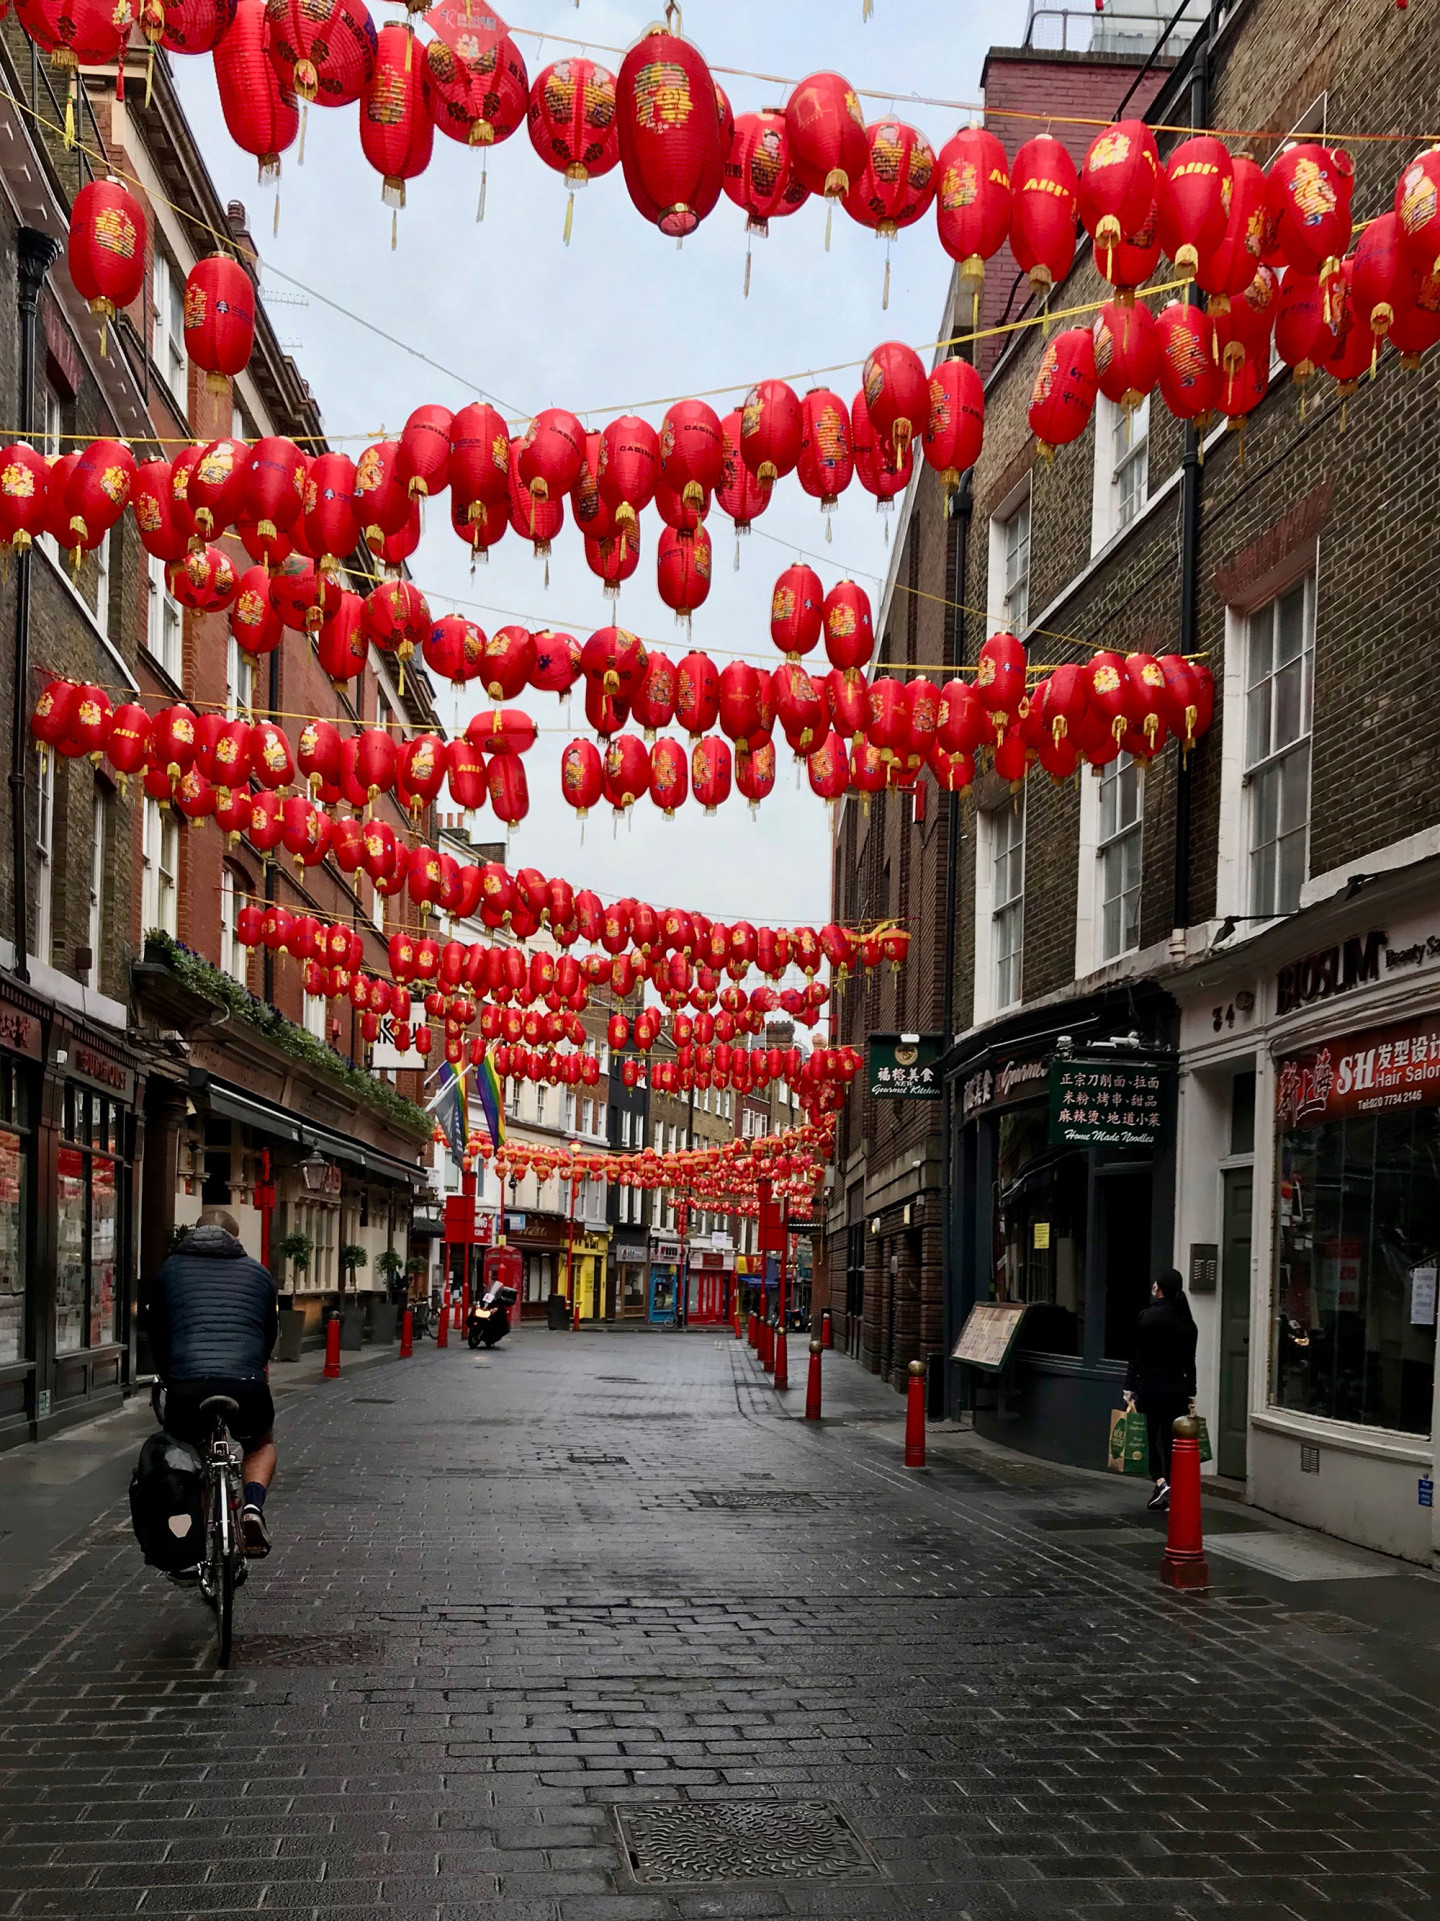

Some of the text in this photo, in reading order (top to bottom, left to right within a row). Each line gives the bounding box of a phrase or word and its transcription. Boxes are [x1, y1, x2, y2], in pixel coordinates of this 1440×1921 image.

[1386, 944, 1426, 968] Beauty
[1336, 1048, 1376, 1095] SH
[1376, 1069, 1402, 1088] Hair
[871, 1084, 941, 1095] Gourmet Kitchen
[1384, 1093, 1402, 1105] 7734
[1403, 1089, 1422, 1103] 2146
[1064, 1129, 1154, 1143] Home Made Noodles
